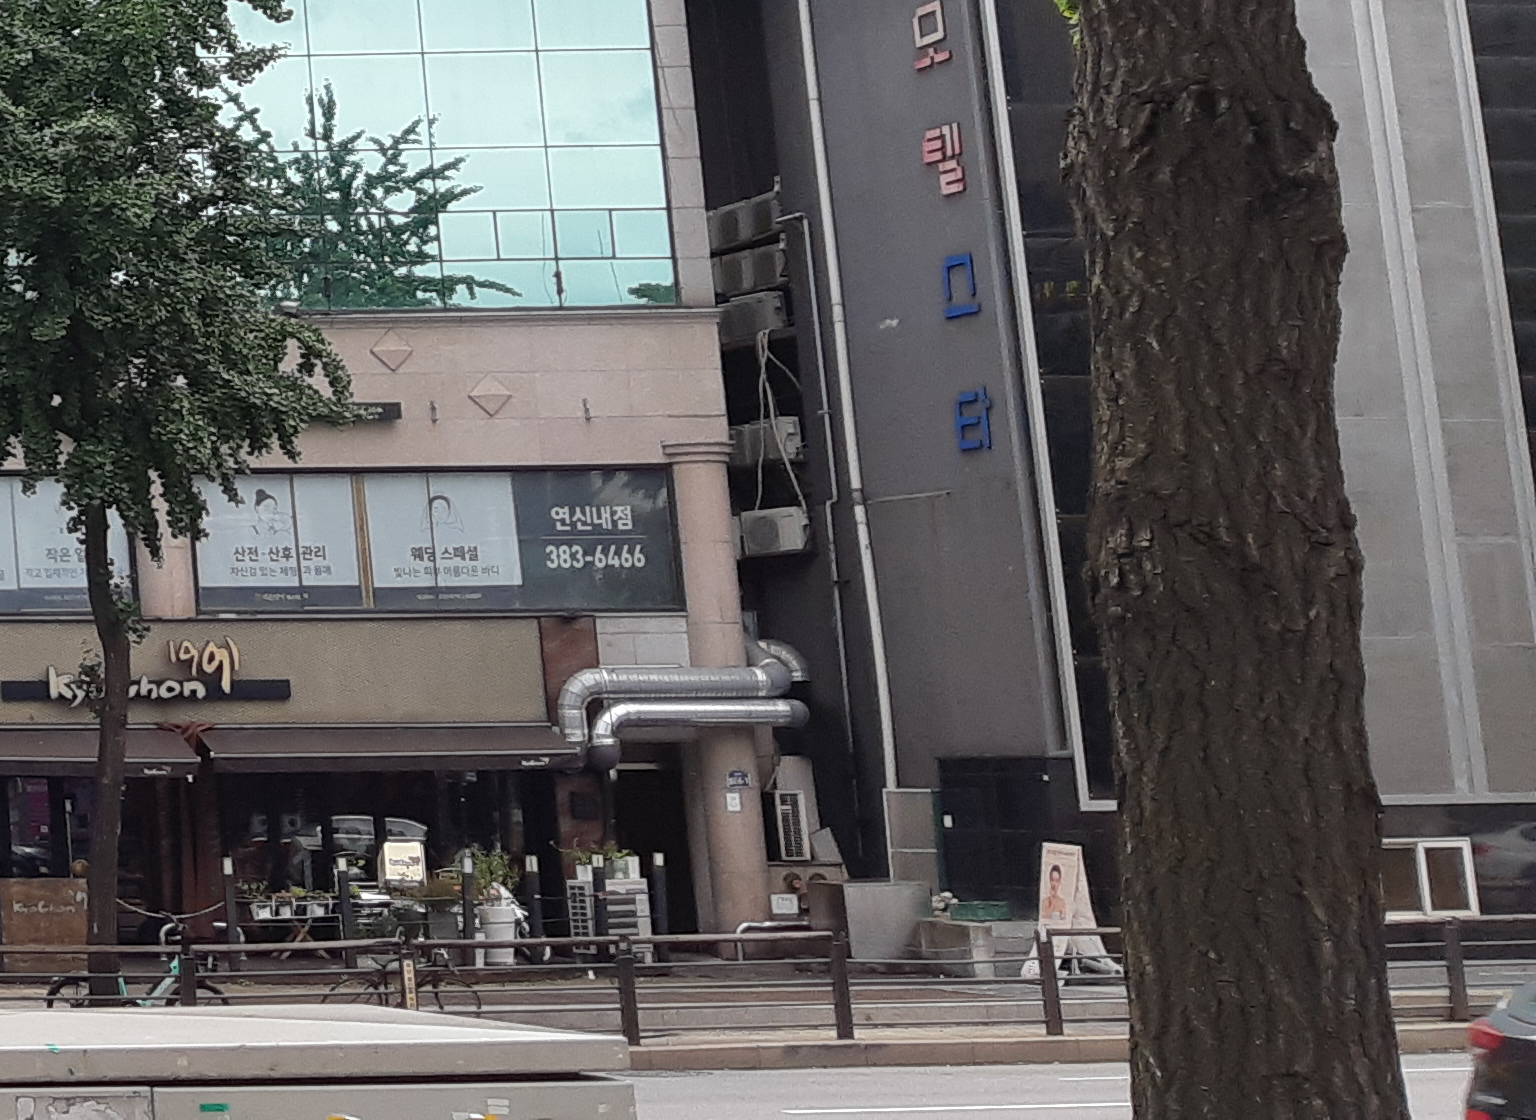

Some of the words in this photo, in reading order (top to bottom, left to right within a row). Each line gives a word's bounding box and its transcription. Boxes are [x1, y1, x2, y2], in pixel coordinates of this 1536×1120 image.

[550, 505, 633, 531] 연신내점
[300, 545, 327, 561] 관리
[545, 544, 646, 569] 383-6466
[168, 635, 241, 695] 1991
